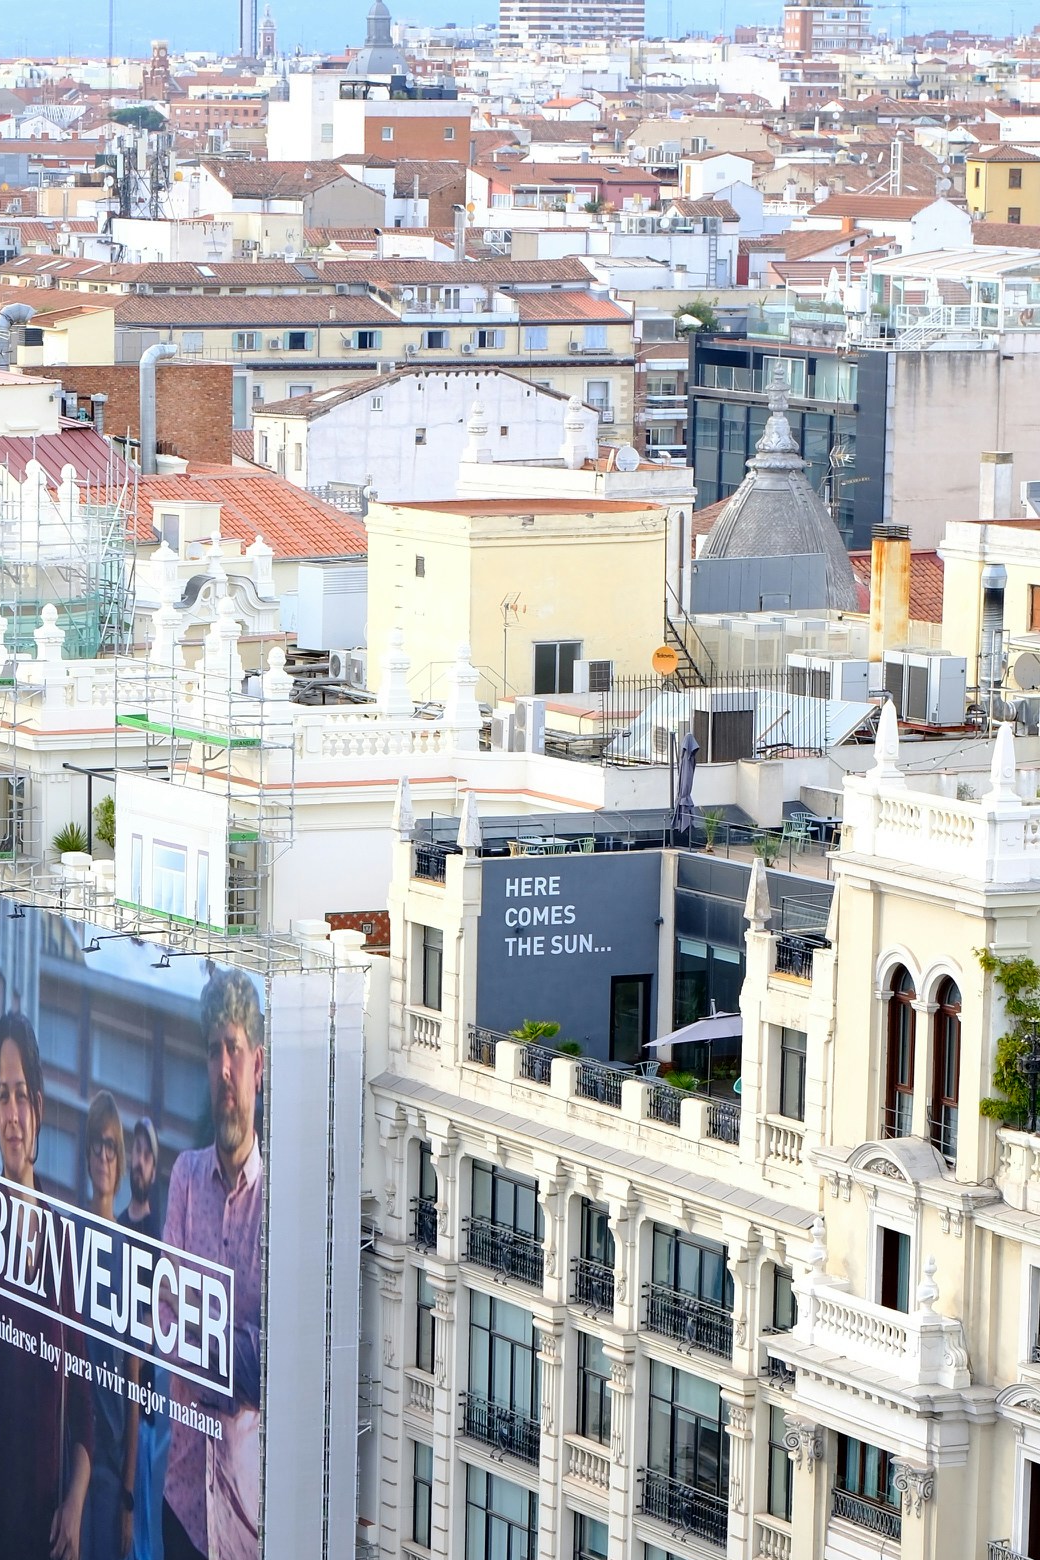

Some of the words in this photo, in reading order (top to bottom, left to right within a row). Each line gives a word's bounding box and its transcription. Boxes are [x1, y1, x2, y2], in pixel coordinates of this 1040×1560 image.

[506, 876, 560, 897] HERE
[505, 905, 576, 927] COMES
[505, 936, 544, 957] THE
[550, 934, 612, 955] SUN...
[40, 1332, 62, 1371] hoy
[64, 1352, 92, 1381] para
[96, 1361, 125, 1395] vivir
[128, 1381, 166, 1415] mejor
[169, 1400, 223, 1440] mañana
